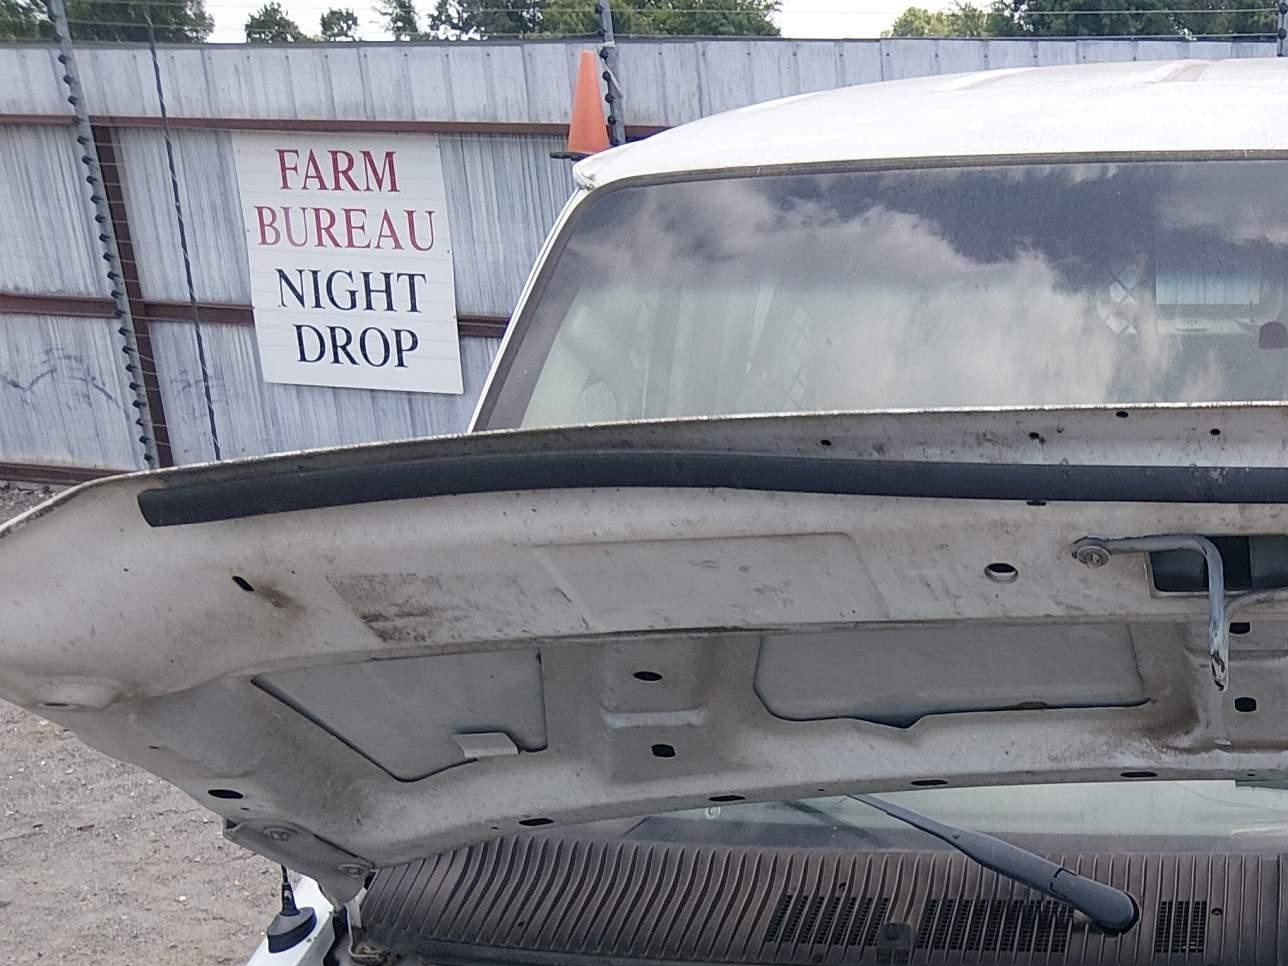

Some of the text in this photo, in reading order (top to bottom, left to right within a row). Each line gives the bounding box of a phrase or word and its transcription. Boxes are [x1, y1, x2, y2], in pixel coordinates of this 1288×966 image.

[276, 148, 401, 193] FARM
[254, 205, 436, 251] BUREAU
[275, 268, 427, 313] NIGHT
[292, 323, 419, 368] DROP
